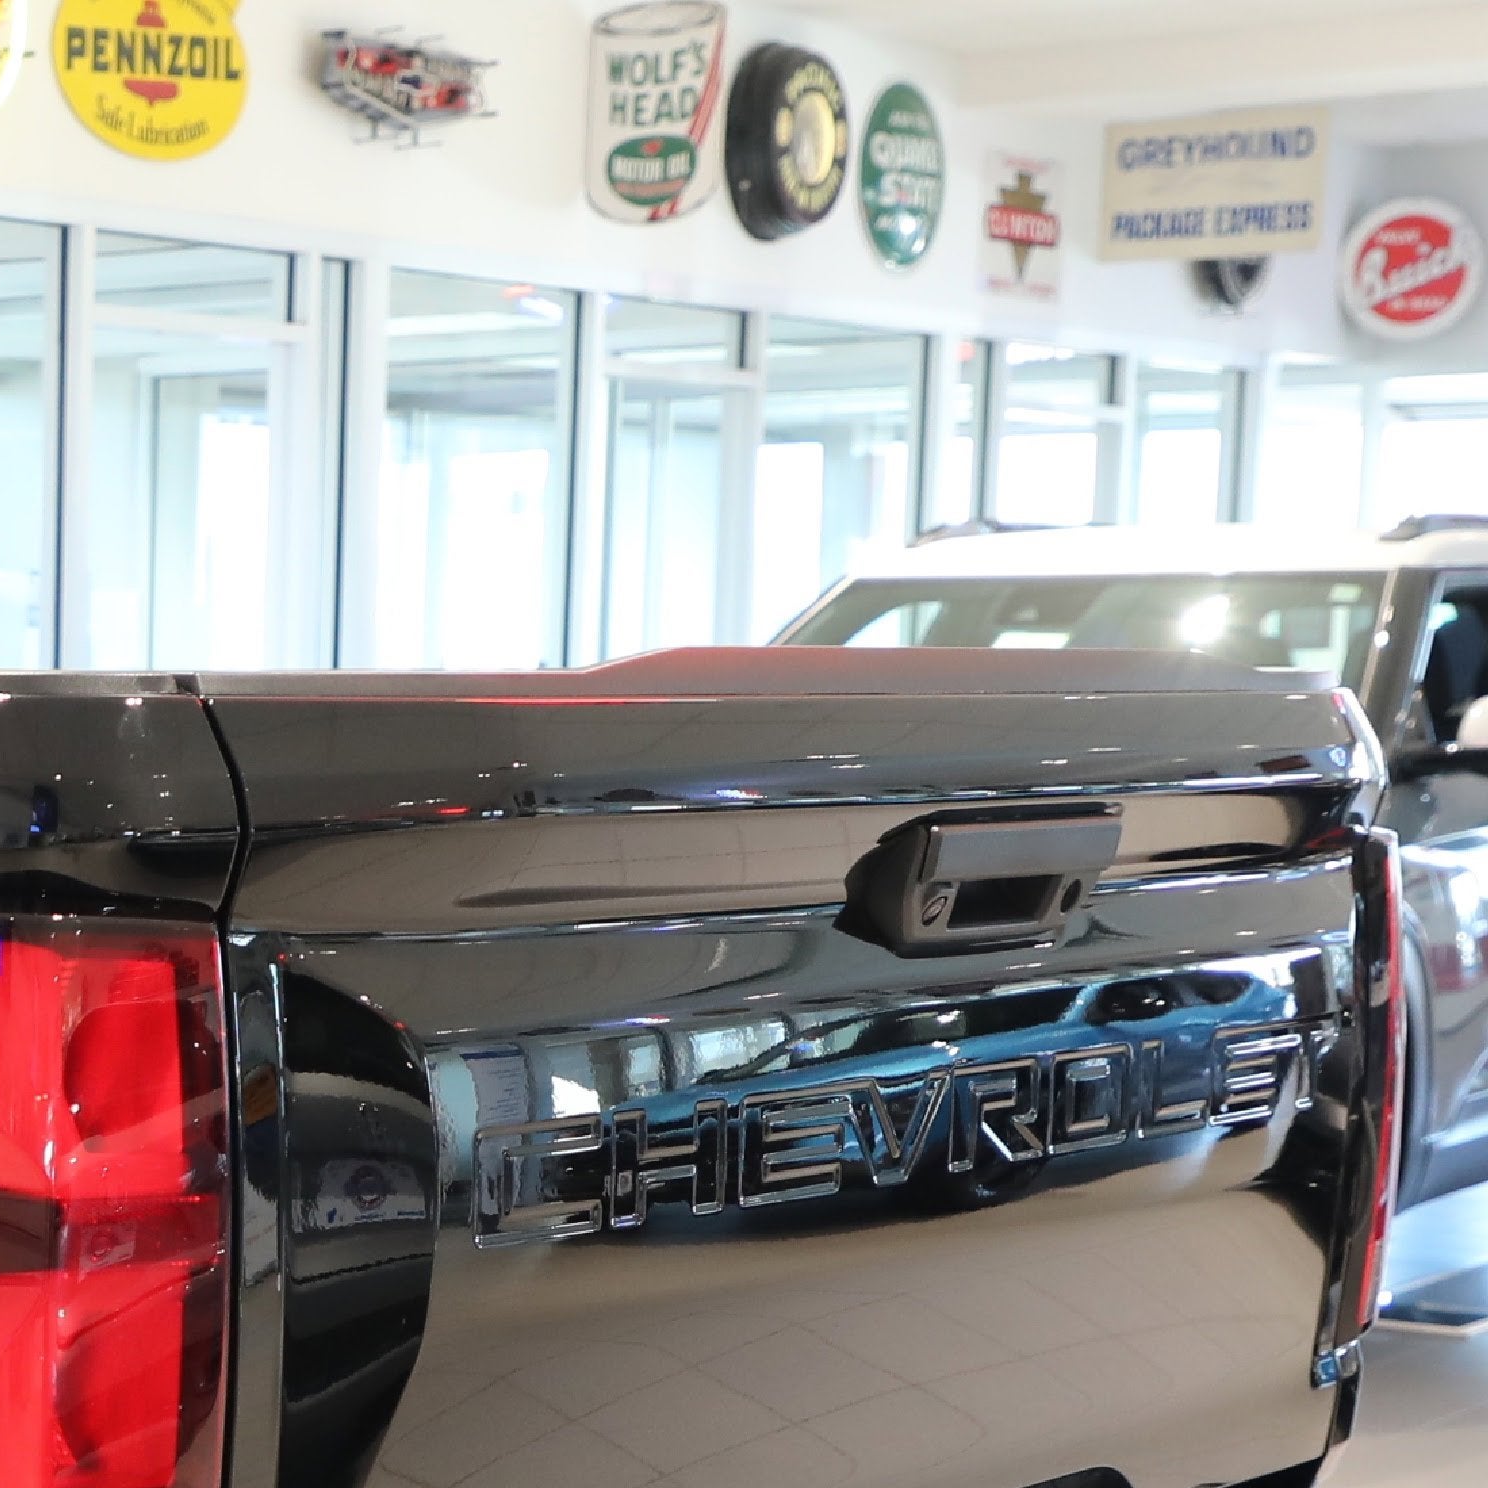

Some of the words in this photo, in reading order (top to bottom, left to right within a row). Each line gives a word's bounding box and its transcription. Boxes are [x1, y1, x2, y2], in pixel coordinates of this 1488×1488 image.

[66, 26, 241, 81] PENNZOIL
[608, 86, 700, 126] HEAD
[1118, 124, 1315, 171] GREYHOUND
[474, 1012, 1340, 1250] CHEVROLET
